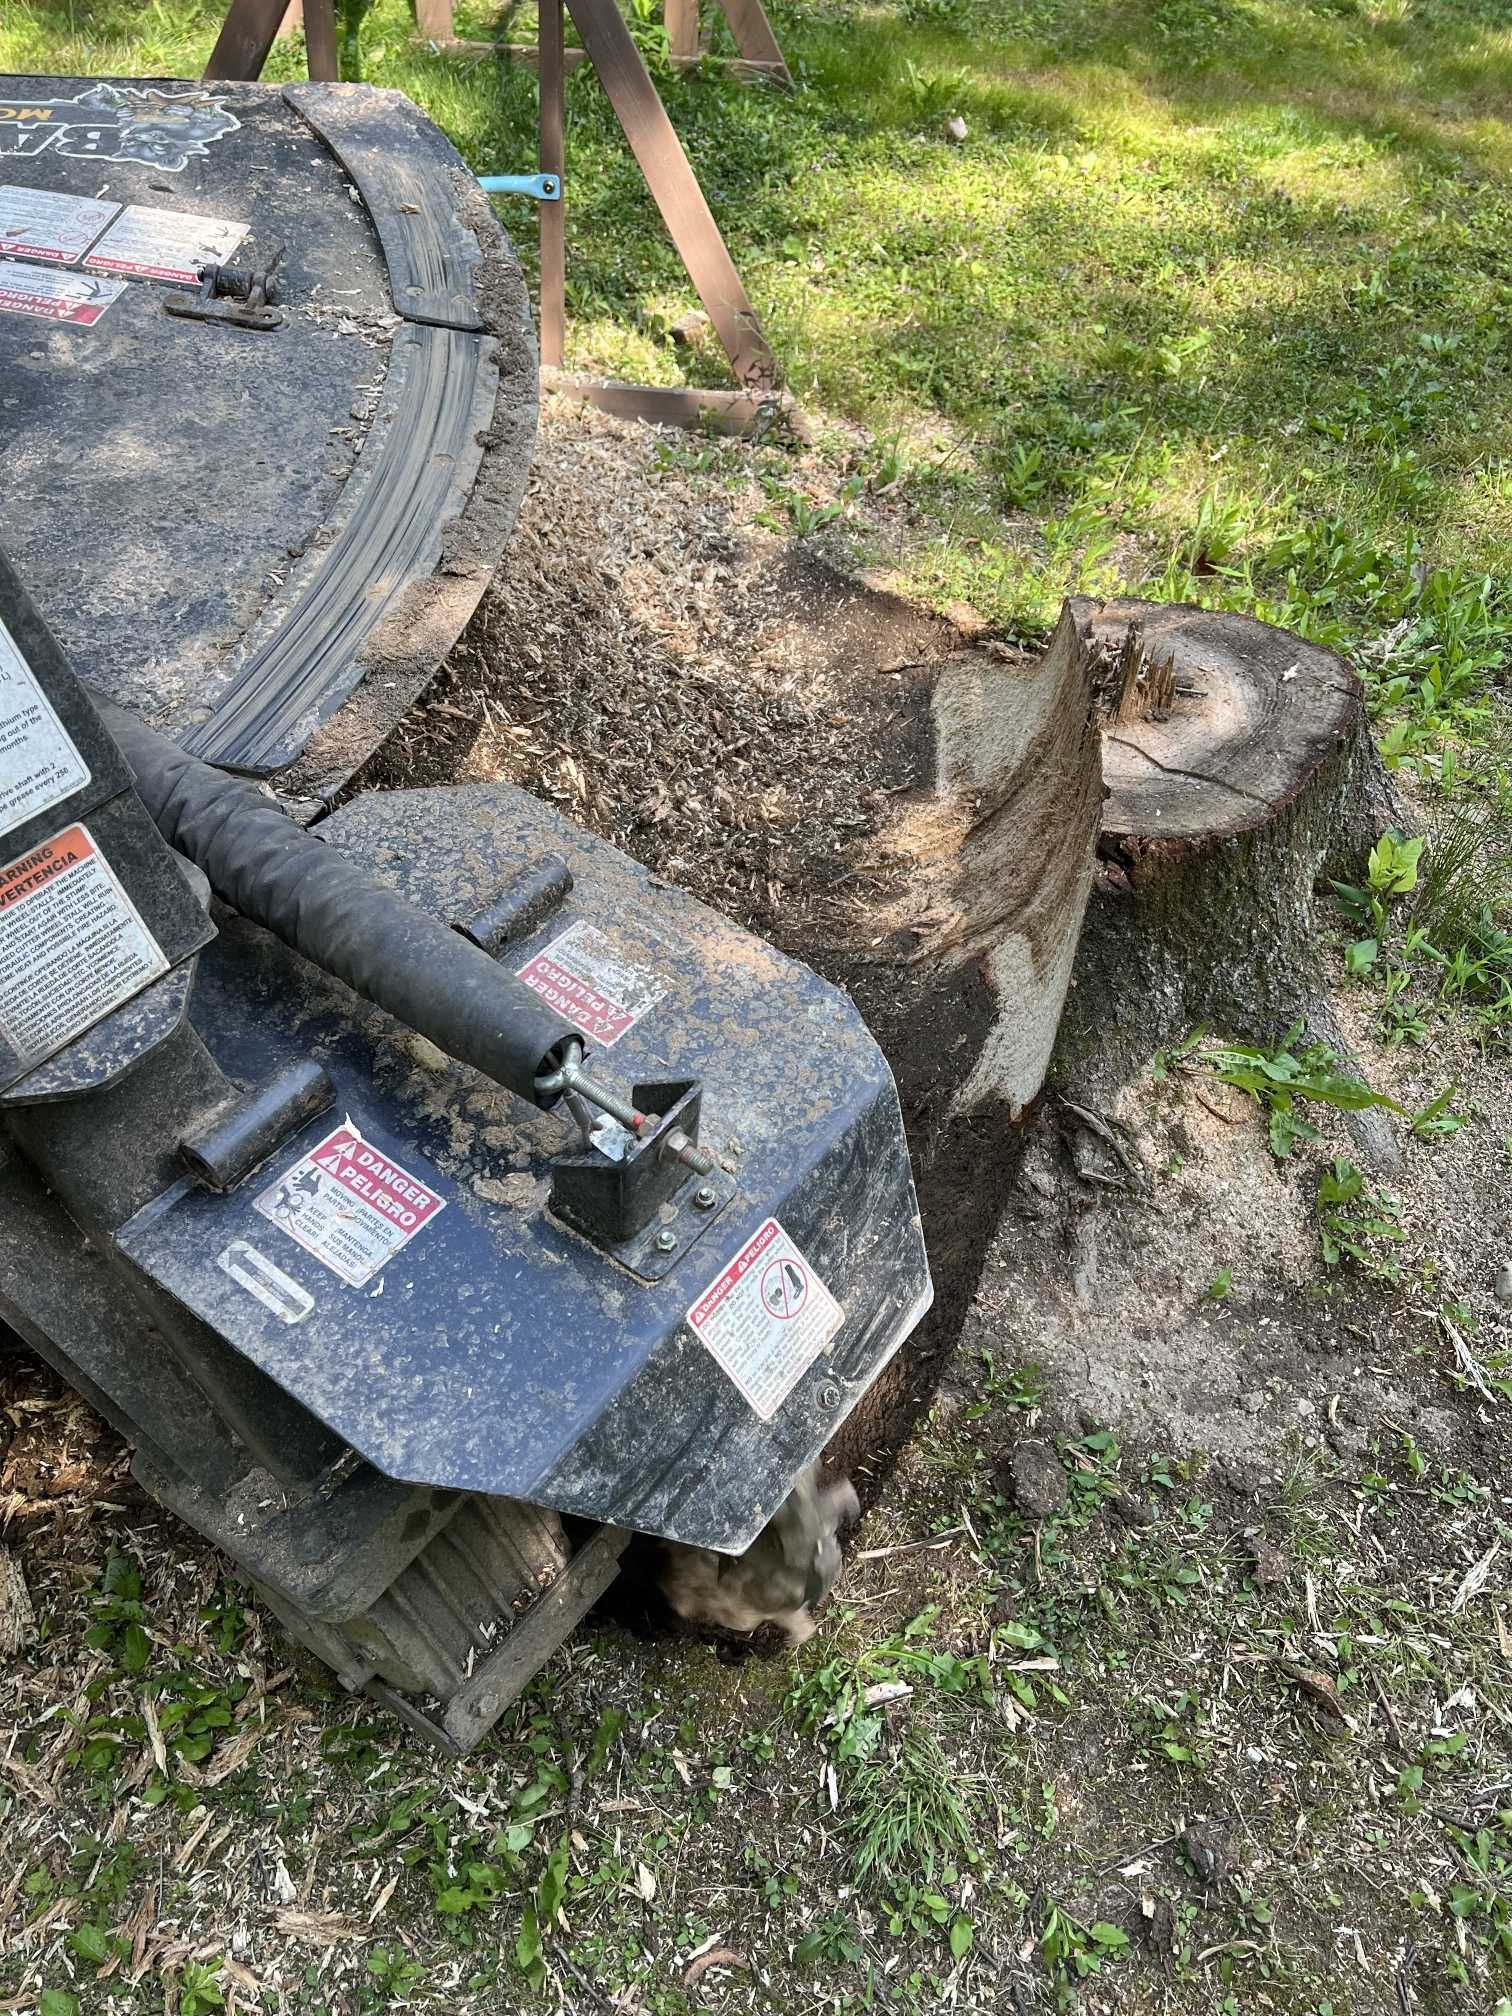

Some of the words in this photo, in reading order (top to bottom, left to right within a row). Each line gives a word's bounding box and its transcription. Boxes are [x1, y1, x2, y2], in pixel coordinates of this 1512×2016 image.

[5, 724, 21, 738] out
[19, 719, 30, 731] of
[28, 712, 43, 725] the
[20, 701, 40, 718] type
[7, 786, 36, 808] grease
[33, 774, 56, 793] every
[12, 774, 34, 791] shaft
[31, 764, 51, 779] with
[5, 909, 31, 929] WHEEL
[55, 866, 97, 896] IMMEDIATELY
[15, 902, 26, 913] TO
[24, 882, 56, 907] OPERATE
[54, 875, 69, 887] THE
[67, 857, 97, 879] MACHINE
[0, 939, 17, 953] AND
[15, 925, 38, 943] START
[35, 912, 58, 930] AGAIN
[56, 902, 74, 916] WITH
[72, 891, 90, 906] LESS
[4, 920, 29, 940] WHEEL
[27, 912, 42, 925] OUT
[51, 897, 65, 909] THE
[13, 933, 41, 954] CUTTER
[39, 917, 65, 937] WHEEL
[62, 905, 83, 922] STALL
[81, 895, 98, 910] WILL
[73, 900, 106, 925] CREATING
[31, 949, 47, 963] AND
[45, 929, 77, 953] POSSIBLE
[76, 920, 90, 933] FIRE
[26, 972, 50, 991] CORTE
[66, 956, 89, 974] CORTE
[536, 961, 606, 1012] PELIGRO
[524, 974, 592, 1024] DANGER
[328, 1185, 357, 1208] MOVING
[337, 1164, 420, 1229] PELIGRO
[354, 1150, 432, 1211] DANGER
[307, 1205, 328, 1222] KEEP
[381, 1226, 395, 1237] EN
[702, 1275, 734, 1312] DANGER
[746, 1227, 775, 1263] PELIGRO
